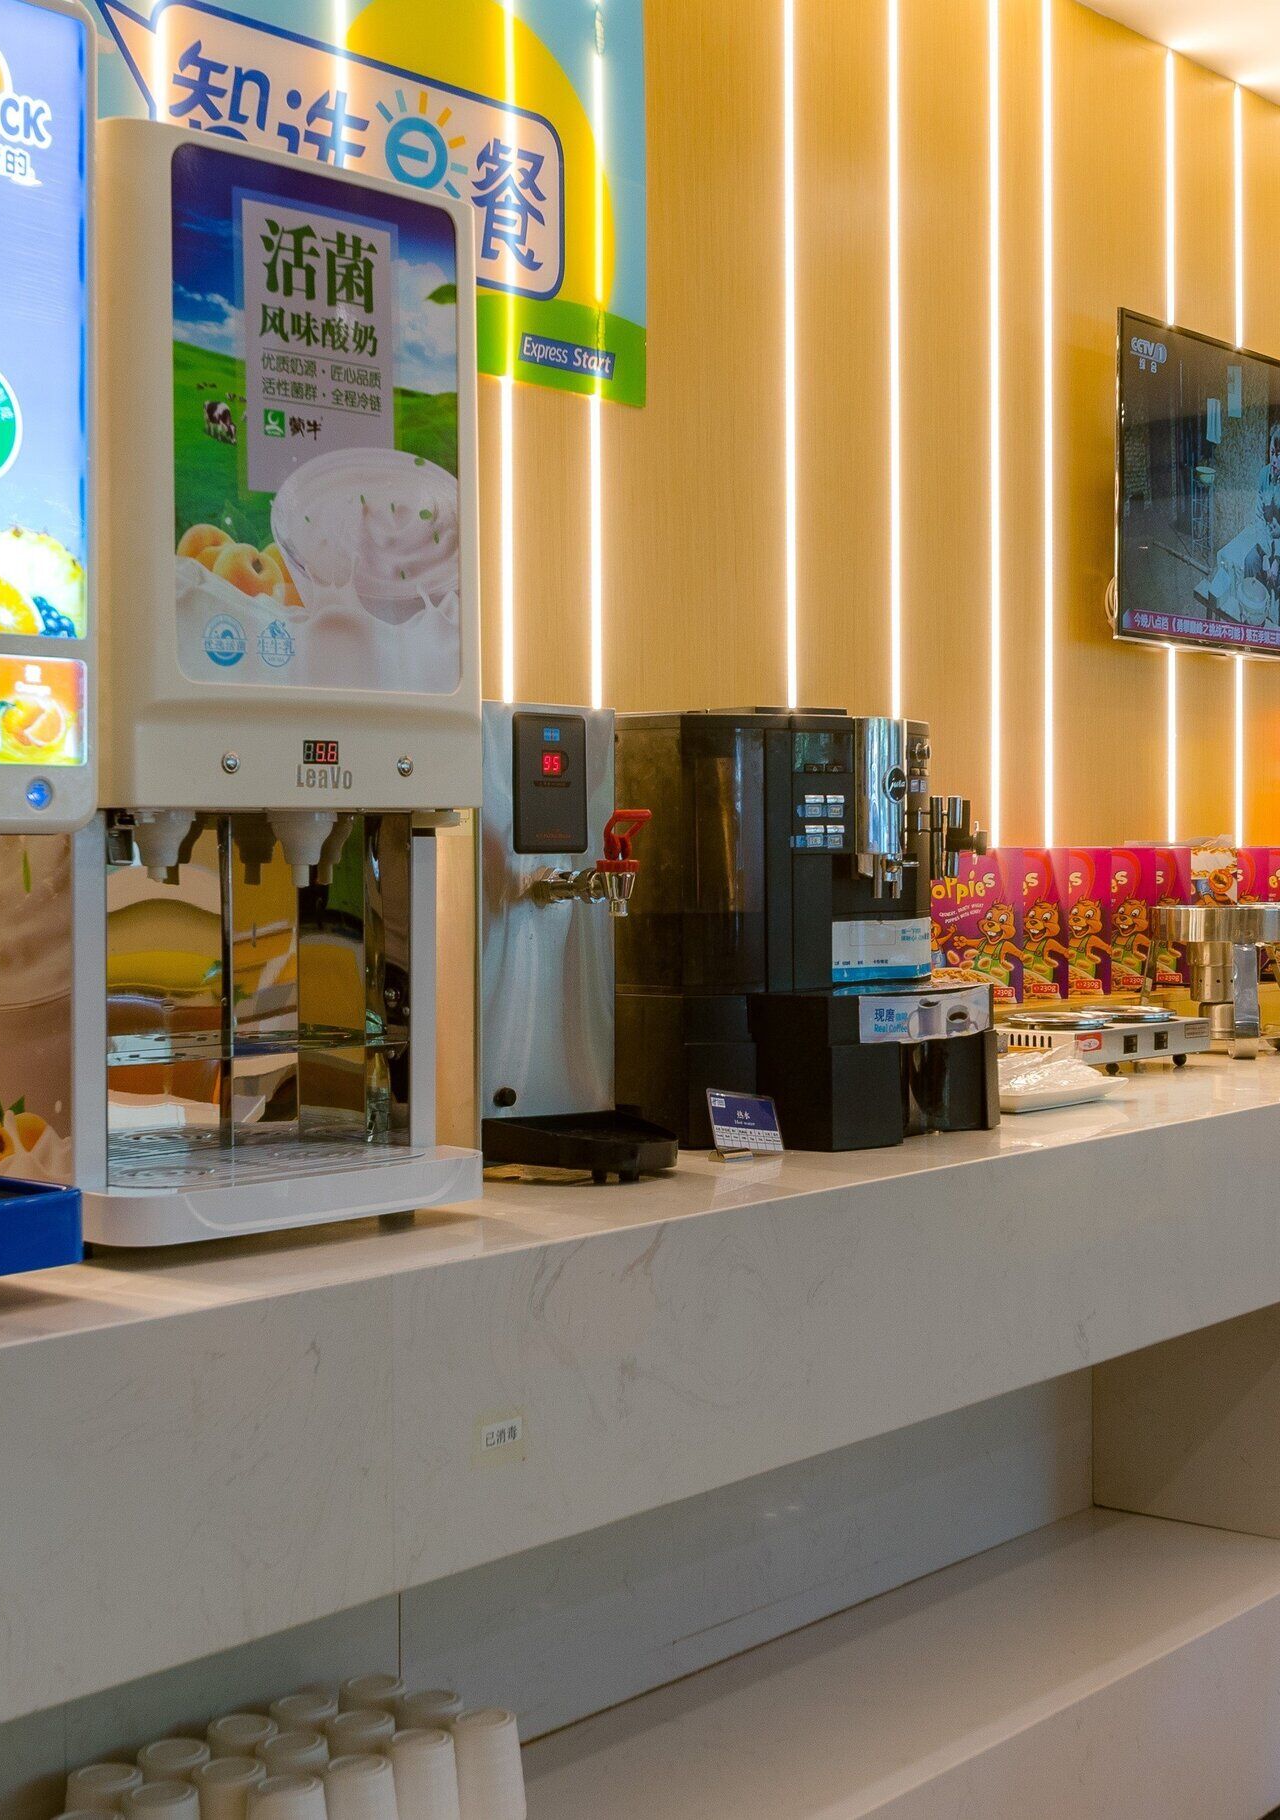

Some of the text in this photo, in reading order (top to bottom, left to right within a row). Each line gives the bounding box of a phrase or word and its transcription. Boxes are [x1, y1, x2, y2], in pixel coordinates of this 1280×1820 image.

[259, 218, 378, 314] 活菌
[259, 303, 378, 357] 风味酸奶
[522, 336, 612, 374] Express Start
[1130, 336, 1155, 357] CCTV
[288, 416, 323, 440] 蒙牛
[543, 755, 561, 772] 95
